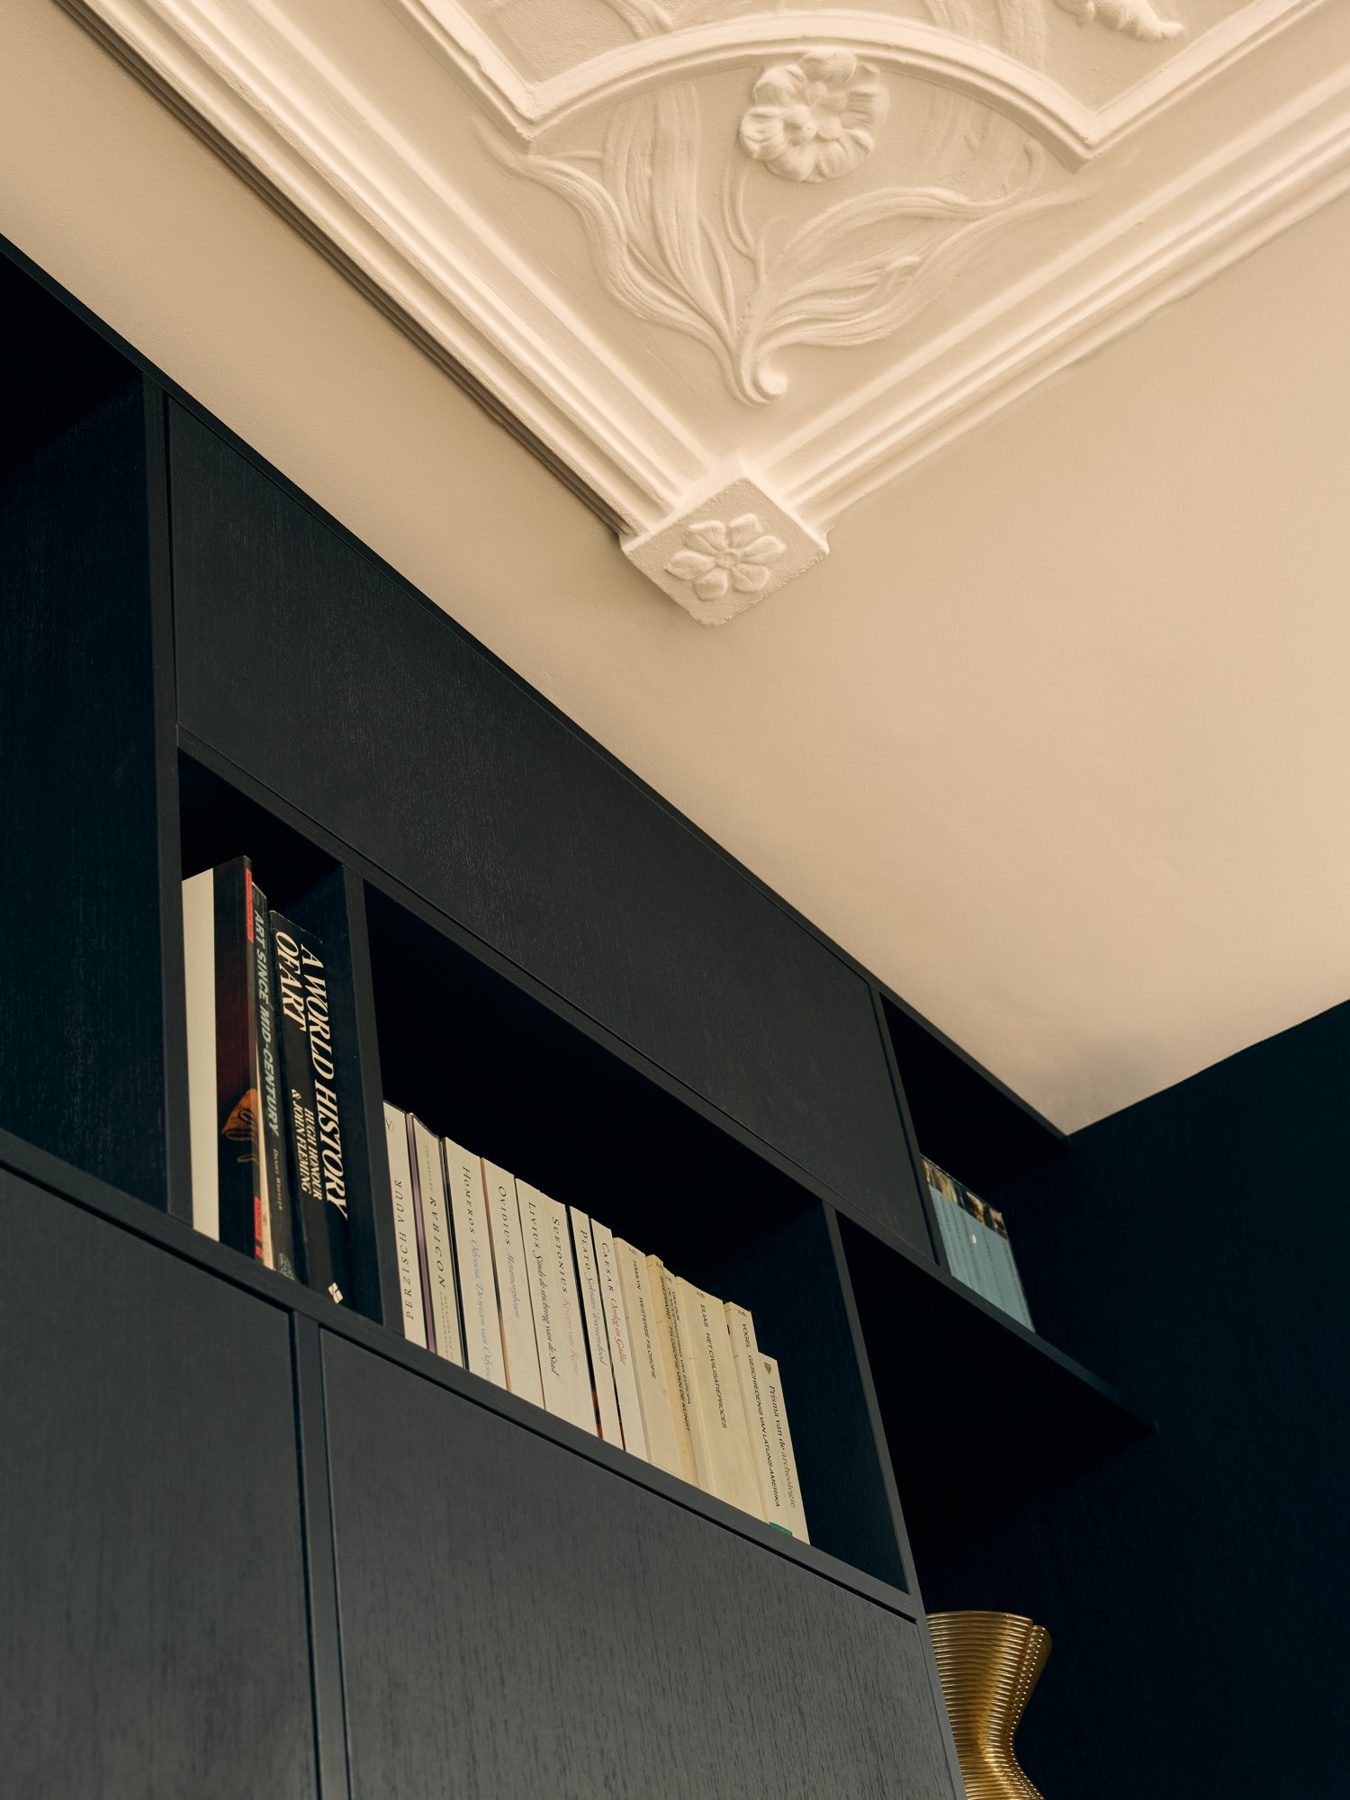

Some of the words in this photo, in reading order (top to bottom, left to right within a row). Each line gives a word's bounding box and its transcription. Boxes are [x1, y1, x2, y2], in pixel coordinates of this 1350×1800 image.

[254, 910, 266, 950] ART
[275, 931, 301, 975] OF
[300, 943, 324, 968] A
[256, 949, 269, 1005] SINCE
[279, 962, 307, 1032] ART
[304, 974, 335, 1080] WORLD
[260, 1005, 279, 1137] MID-CENTURY
[291, 1088, 302, 1100] &
[293, 1100, 305, 1137] JOHN
[304, 1107, 317, 1146] HUGH
[297, 1135, 312, 1194] FLEMING
[307, 1146, 322, 1200] HONOUR
[315, 1079, 348, 1221] HISTORY
[394, 1180, 405, 1223] VUUR
[462, 1166, 475, 1233] HOMEROS
[498, 1185, 511, 1246] OVIDIUS
[528, 1201, 540, 1249] LIVIUS
[429, 1197, 446, 1288] RVBICON
[552, 1216, 567, 1293] SUETONIUS
[602, 1242, 615, 1292] CAESAR
[399, 1231, 414, 1320] PERZISCH
[700, 1304, 709, 1328] ELIAS
